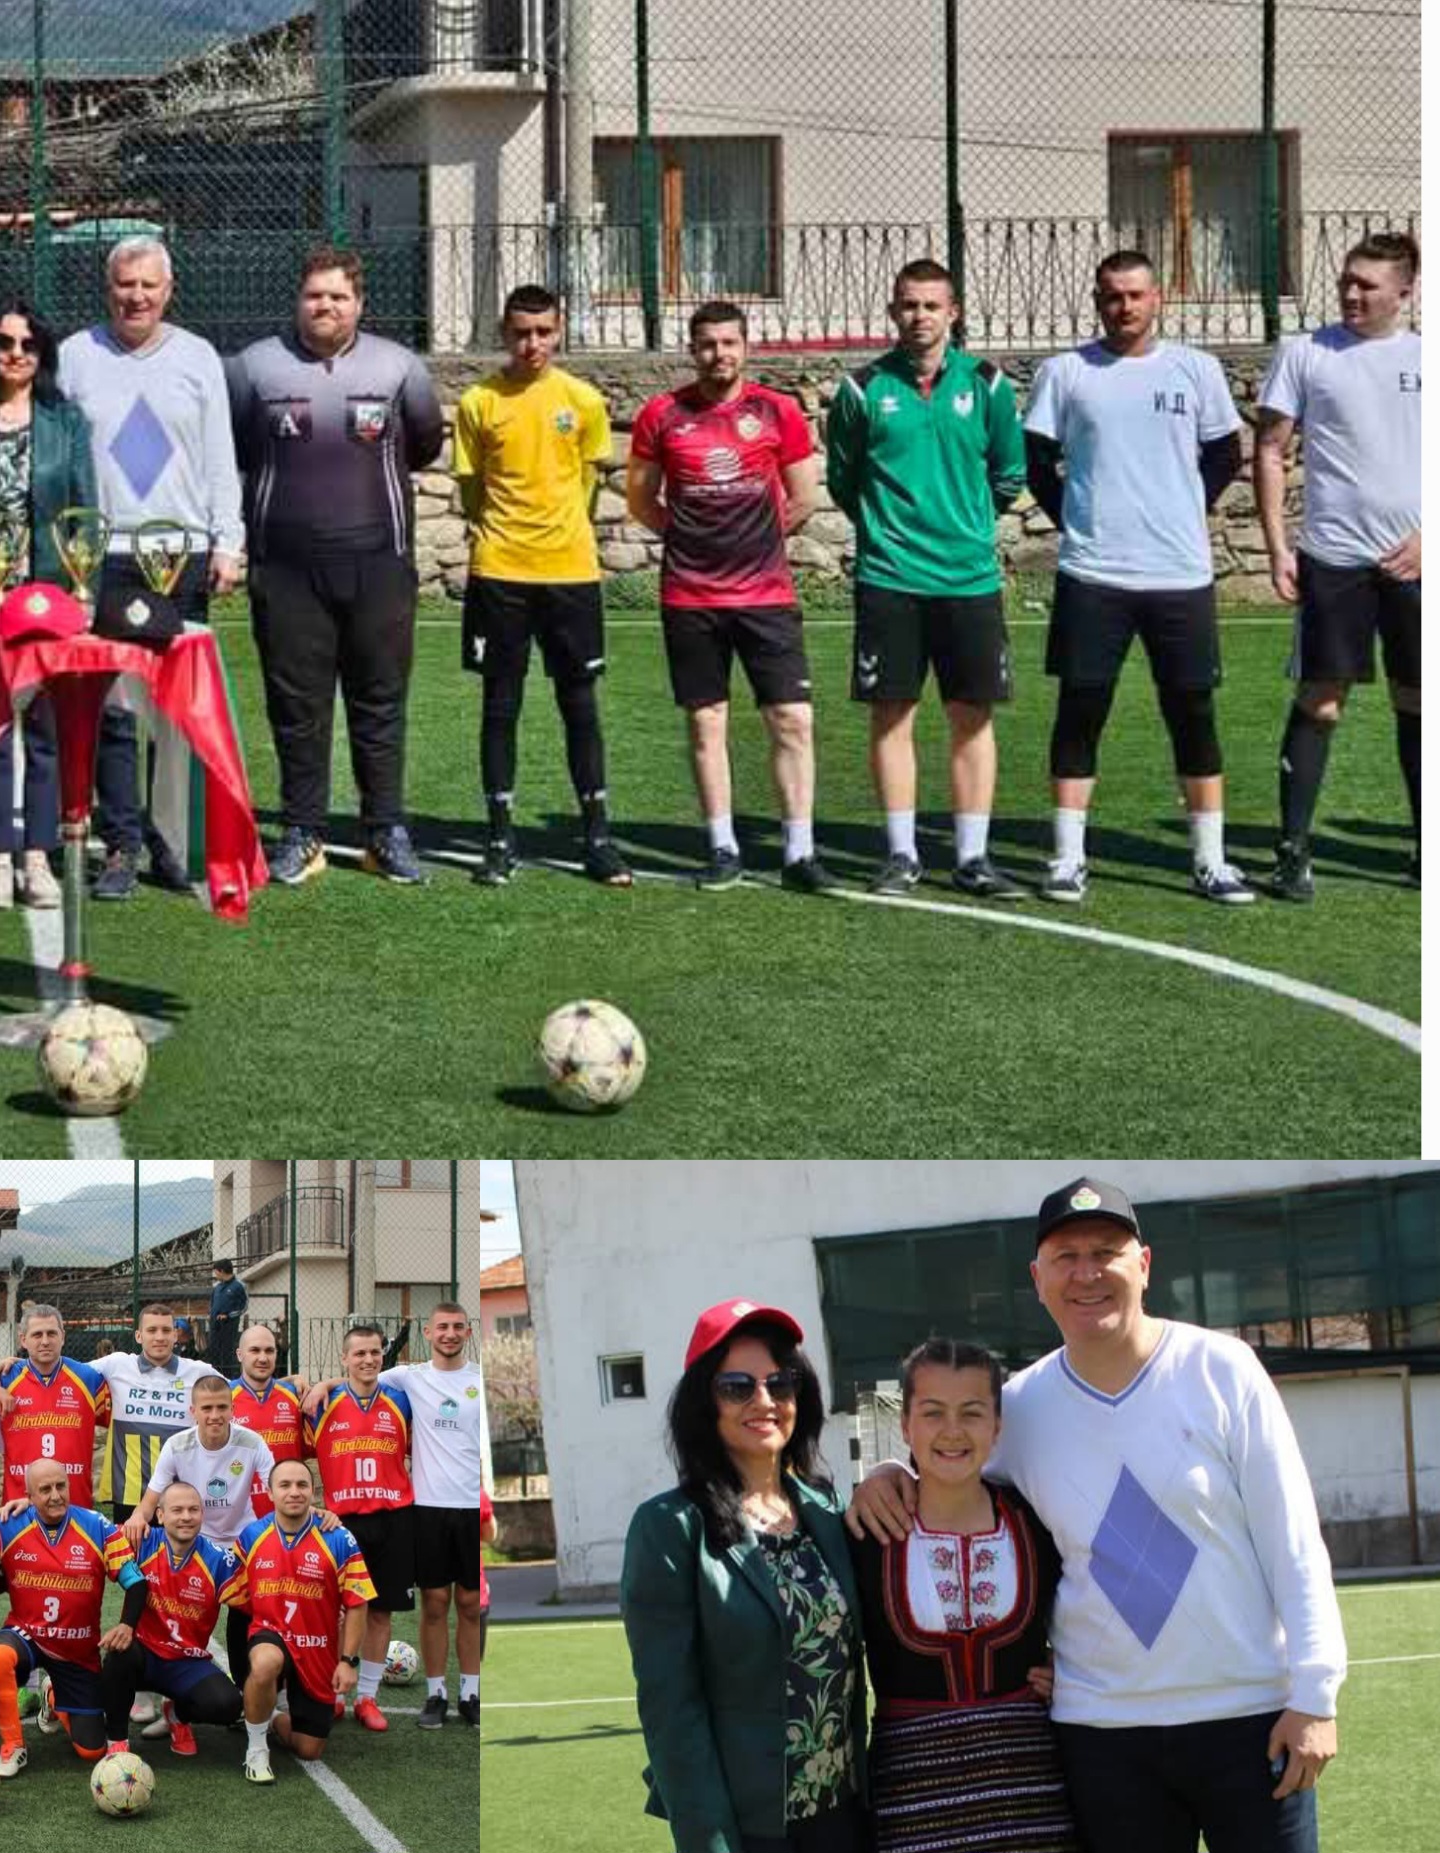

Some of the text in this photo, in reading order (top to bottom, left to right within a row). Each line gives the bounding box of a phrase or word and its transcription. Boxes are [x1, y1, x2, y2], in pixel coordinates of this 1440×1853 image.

[129, 1388, 185, 1403] RZ & PC
[13, 1412, 82, 1428] Mirabilandia
[126, 1404, 186, 1419] De Mors
[434, 1419, 460, 1429] BETL
[41, 1433, 55, 1457] 9
[331, 1436, 398, 1457] Mirabilandia
[355, 1458, 376, 1483] 10
[205, 1498, 231, 1507] BETL
[15, 1571, 92, 1591] Mirabilandia
[43, 1597, 59, 1622] 3
[284, 1601, 297, 1624] 7
